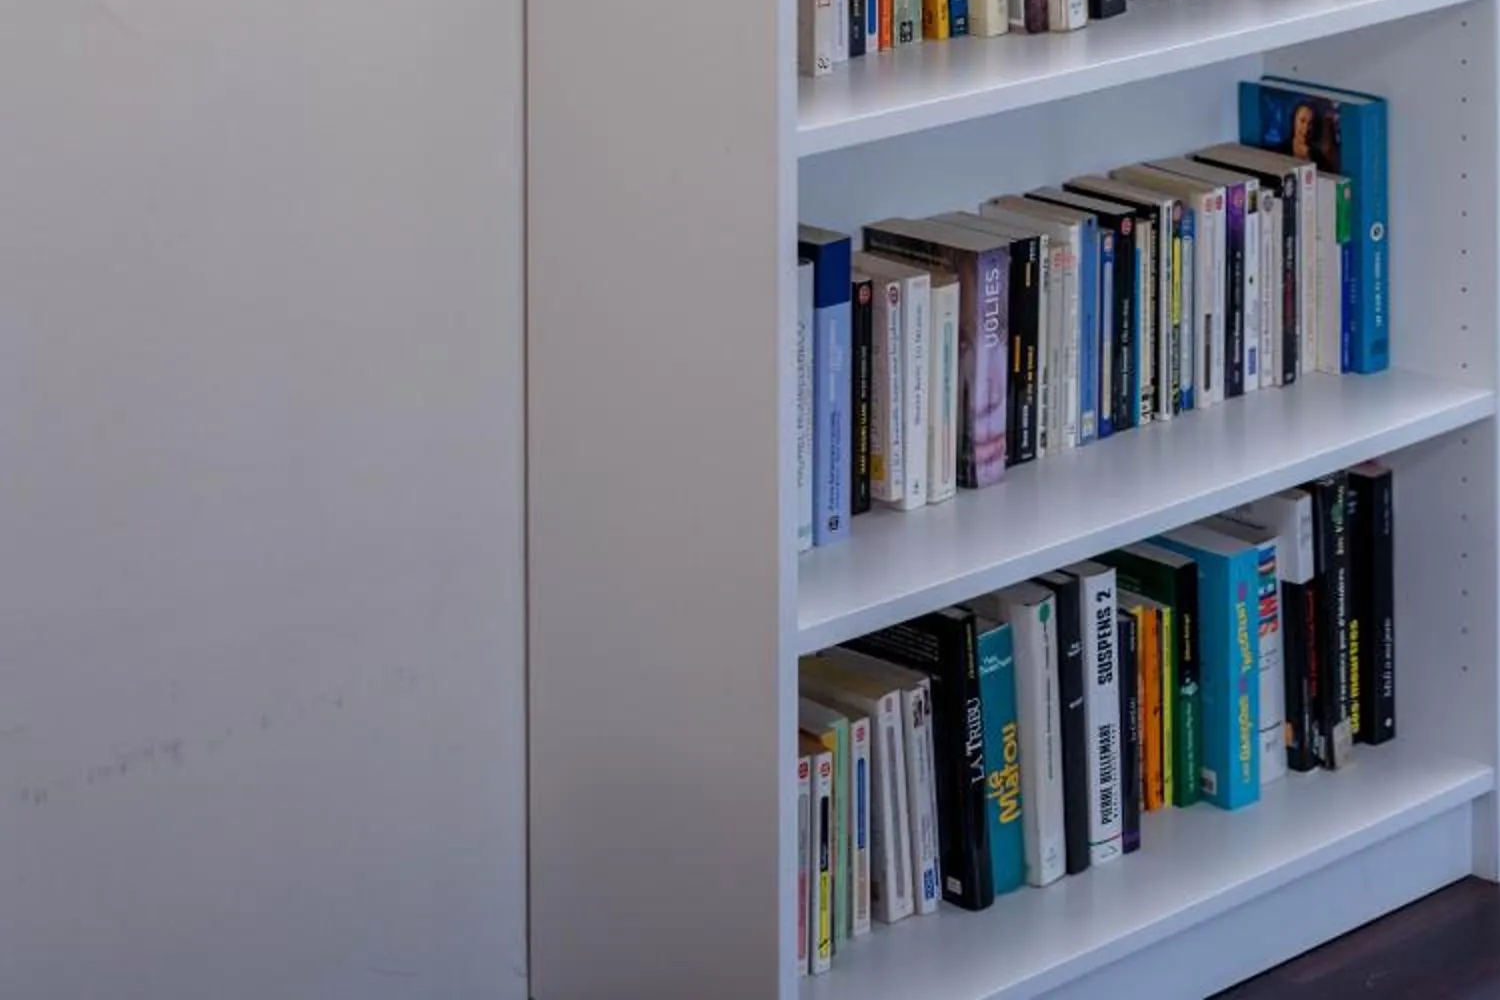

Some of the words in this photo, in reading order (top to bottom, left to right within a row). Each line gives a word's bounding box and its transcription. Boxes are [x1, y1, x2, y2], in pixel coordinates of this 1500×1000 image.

[983, 267, 1000, 348] UGLIES
[1096, 588, 1111, 604] 2
[1096, 607, 1114, 686] SUSPENS
[964, 696, 982, 757] TRIBU
[1097, 723, 1113, 785] BELLEMARE
[969, 753, 985, 784] LA
[985, 770, 1004, 799] Le
[998, 721, 1022, 825] Matou
[1098, 786, 1113, 826] PIERRE
